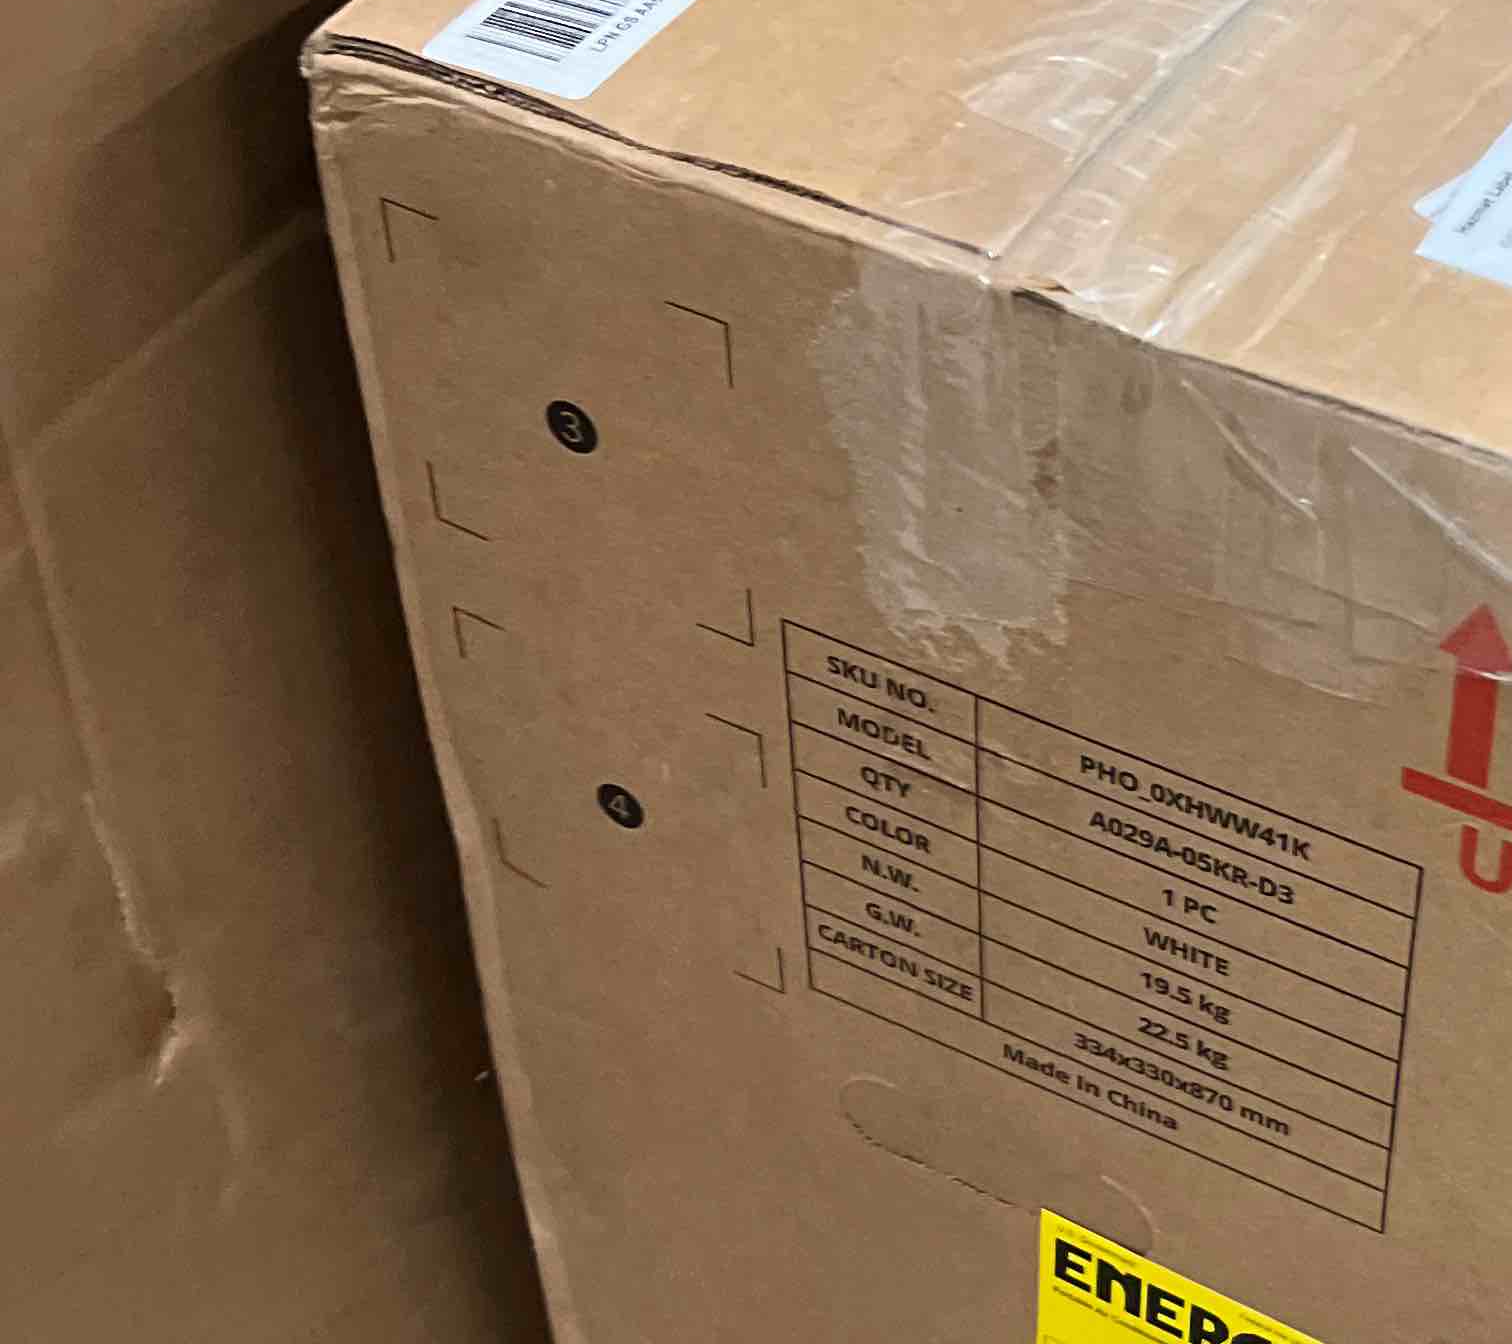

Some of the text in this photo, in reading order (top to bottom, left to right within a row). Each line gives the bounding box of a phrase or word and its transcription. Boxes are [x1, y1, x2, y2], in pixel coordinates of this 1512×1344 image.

[560, 411, 583, 443] 3
[826, 655, 936, 712] SKU NO.
[837, 707, 930, 759] MODEL
[608, 795, 631, 819] 4
[861, 765, 910, 799] QTY
[845, 805, 931, 854] COLOR
[861, 855, 920, 893] N.W.
[1090, 810, 1296, 905] A029A-05KR-D3
[865, 901, 921, 937] G.W.
[1183, 896, 1218, 925] PC
[818, 923, 973, 1002] CARTON SIZE
[1144, 926, 1230, 976] WHITE
[1139, 971, 1232, 1026] 19.5 kg
[1137, 1016, 1230, 1071] 22.5 kg
[1002, 1044, 1071, 1085] Made
[1107, 1089, 1179, 1131] China
[1073, 1032, 1290, 1136] 334x330x870 mm
